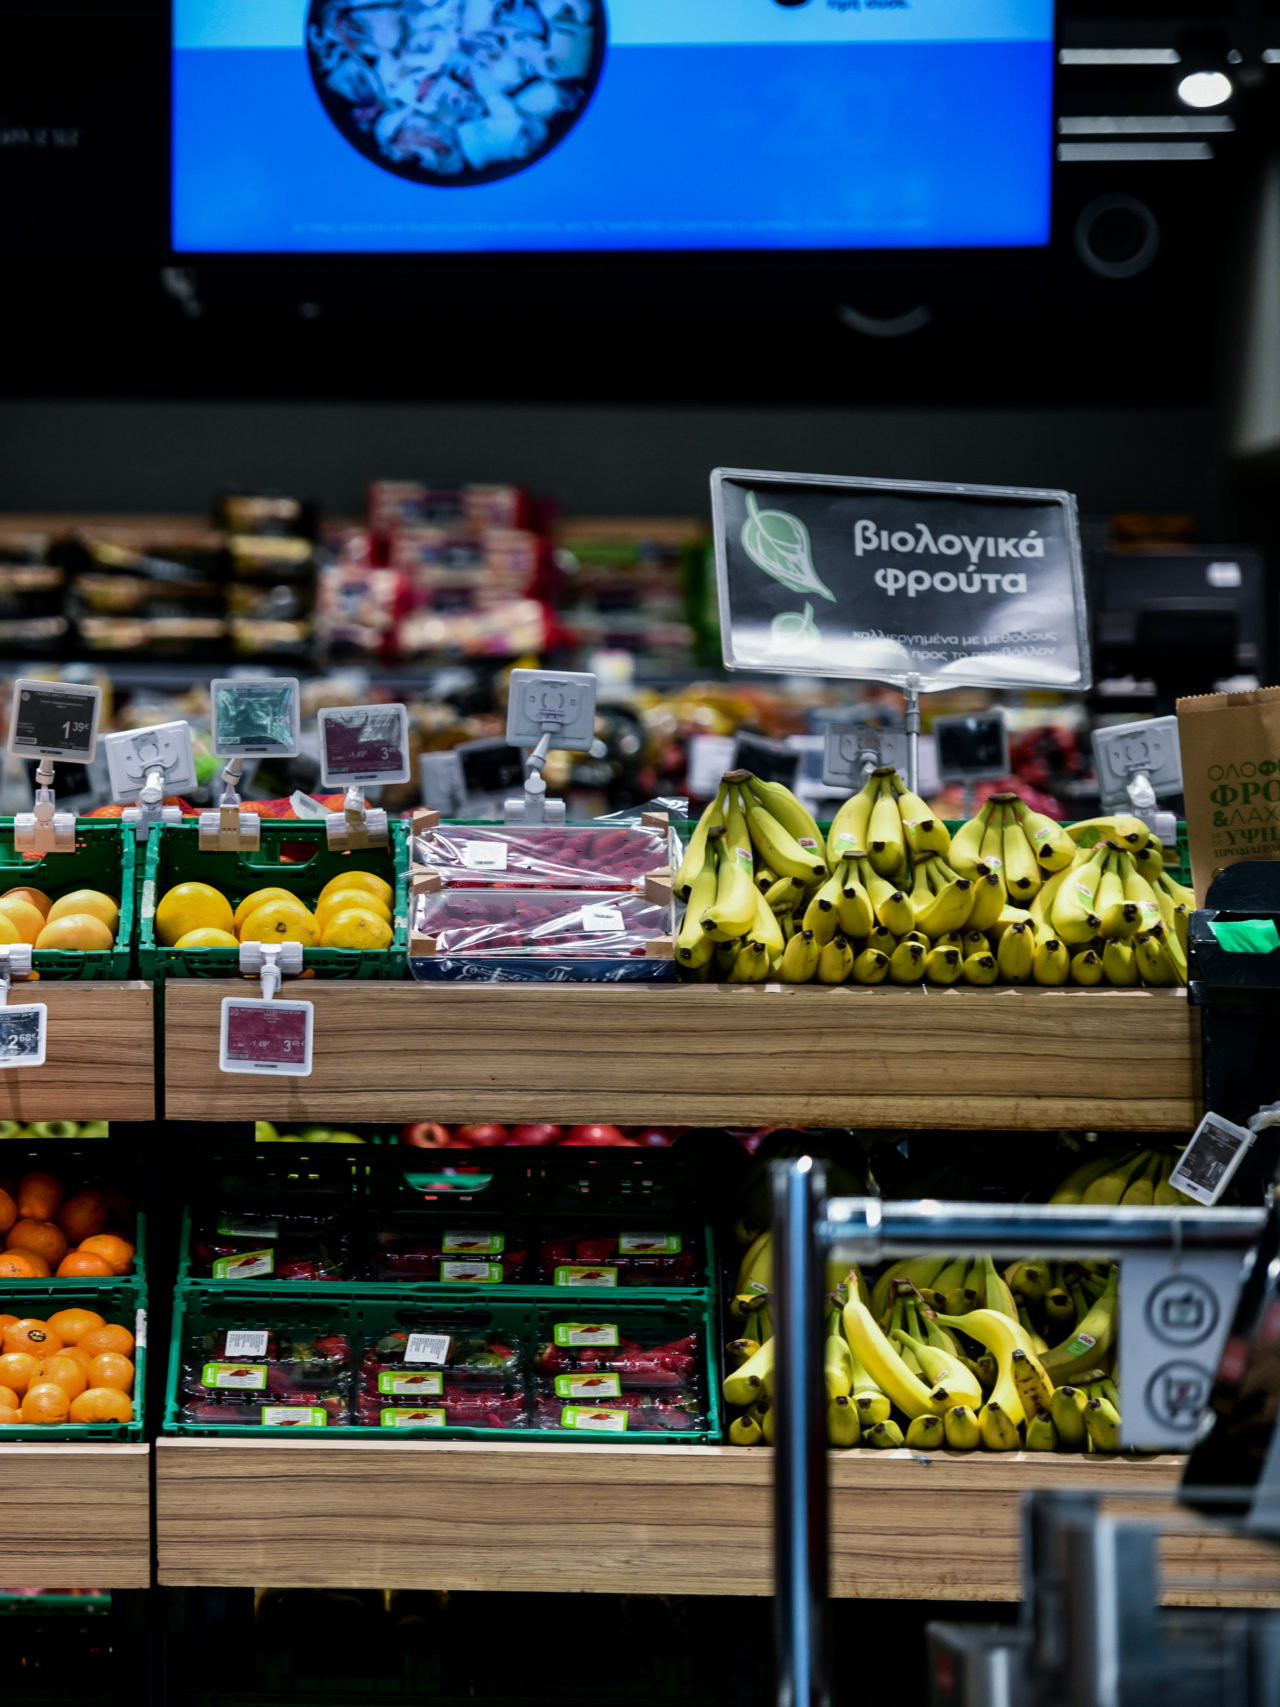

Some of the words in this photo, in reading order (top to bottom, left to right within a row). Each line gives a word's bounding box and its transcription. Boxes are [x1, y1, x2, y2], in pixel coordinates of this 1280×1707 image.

[854, 519, 1045, 563] βιολογικά
[874, 564, 1028, 597] φρούτα
[962, 635, 980, 646] με
[911, 650, 948, 661] προς
[1208, 759, 1280, 782] ΟΛΟΦ
